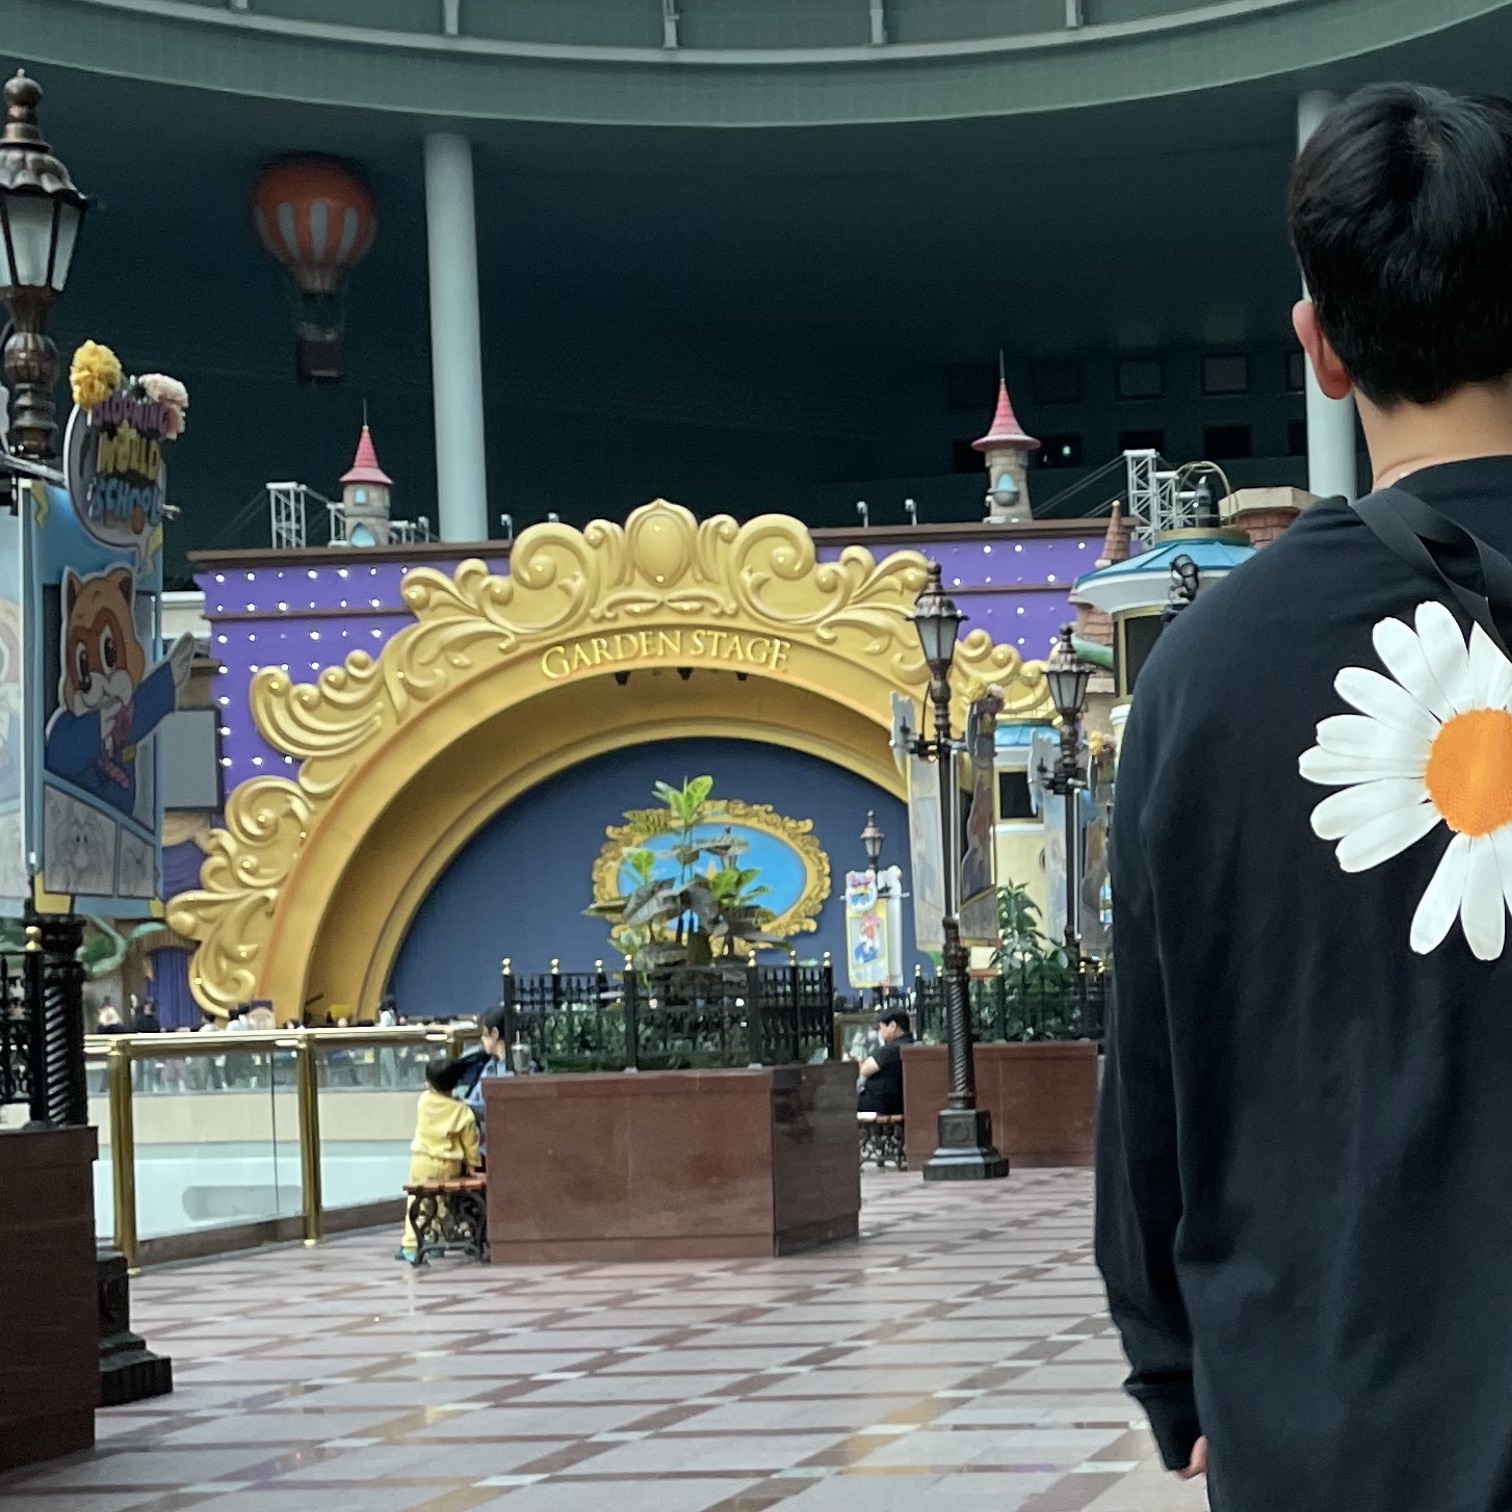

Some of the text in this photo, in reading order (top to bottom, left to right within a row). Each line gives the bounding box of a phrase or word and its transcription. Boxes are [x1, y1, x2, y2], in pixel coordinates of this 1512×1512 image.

[91, 478, 161, 526] SCHOOL
[541, 629, 791, 680] GARDEN STAGE
